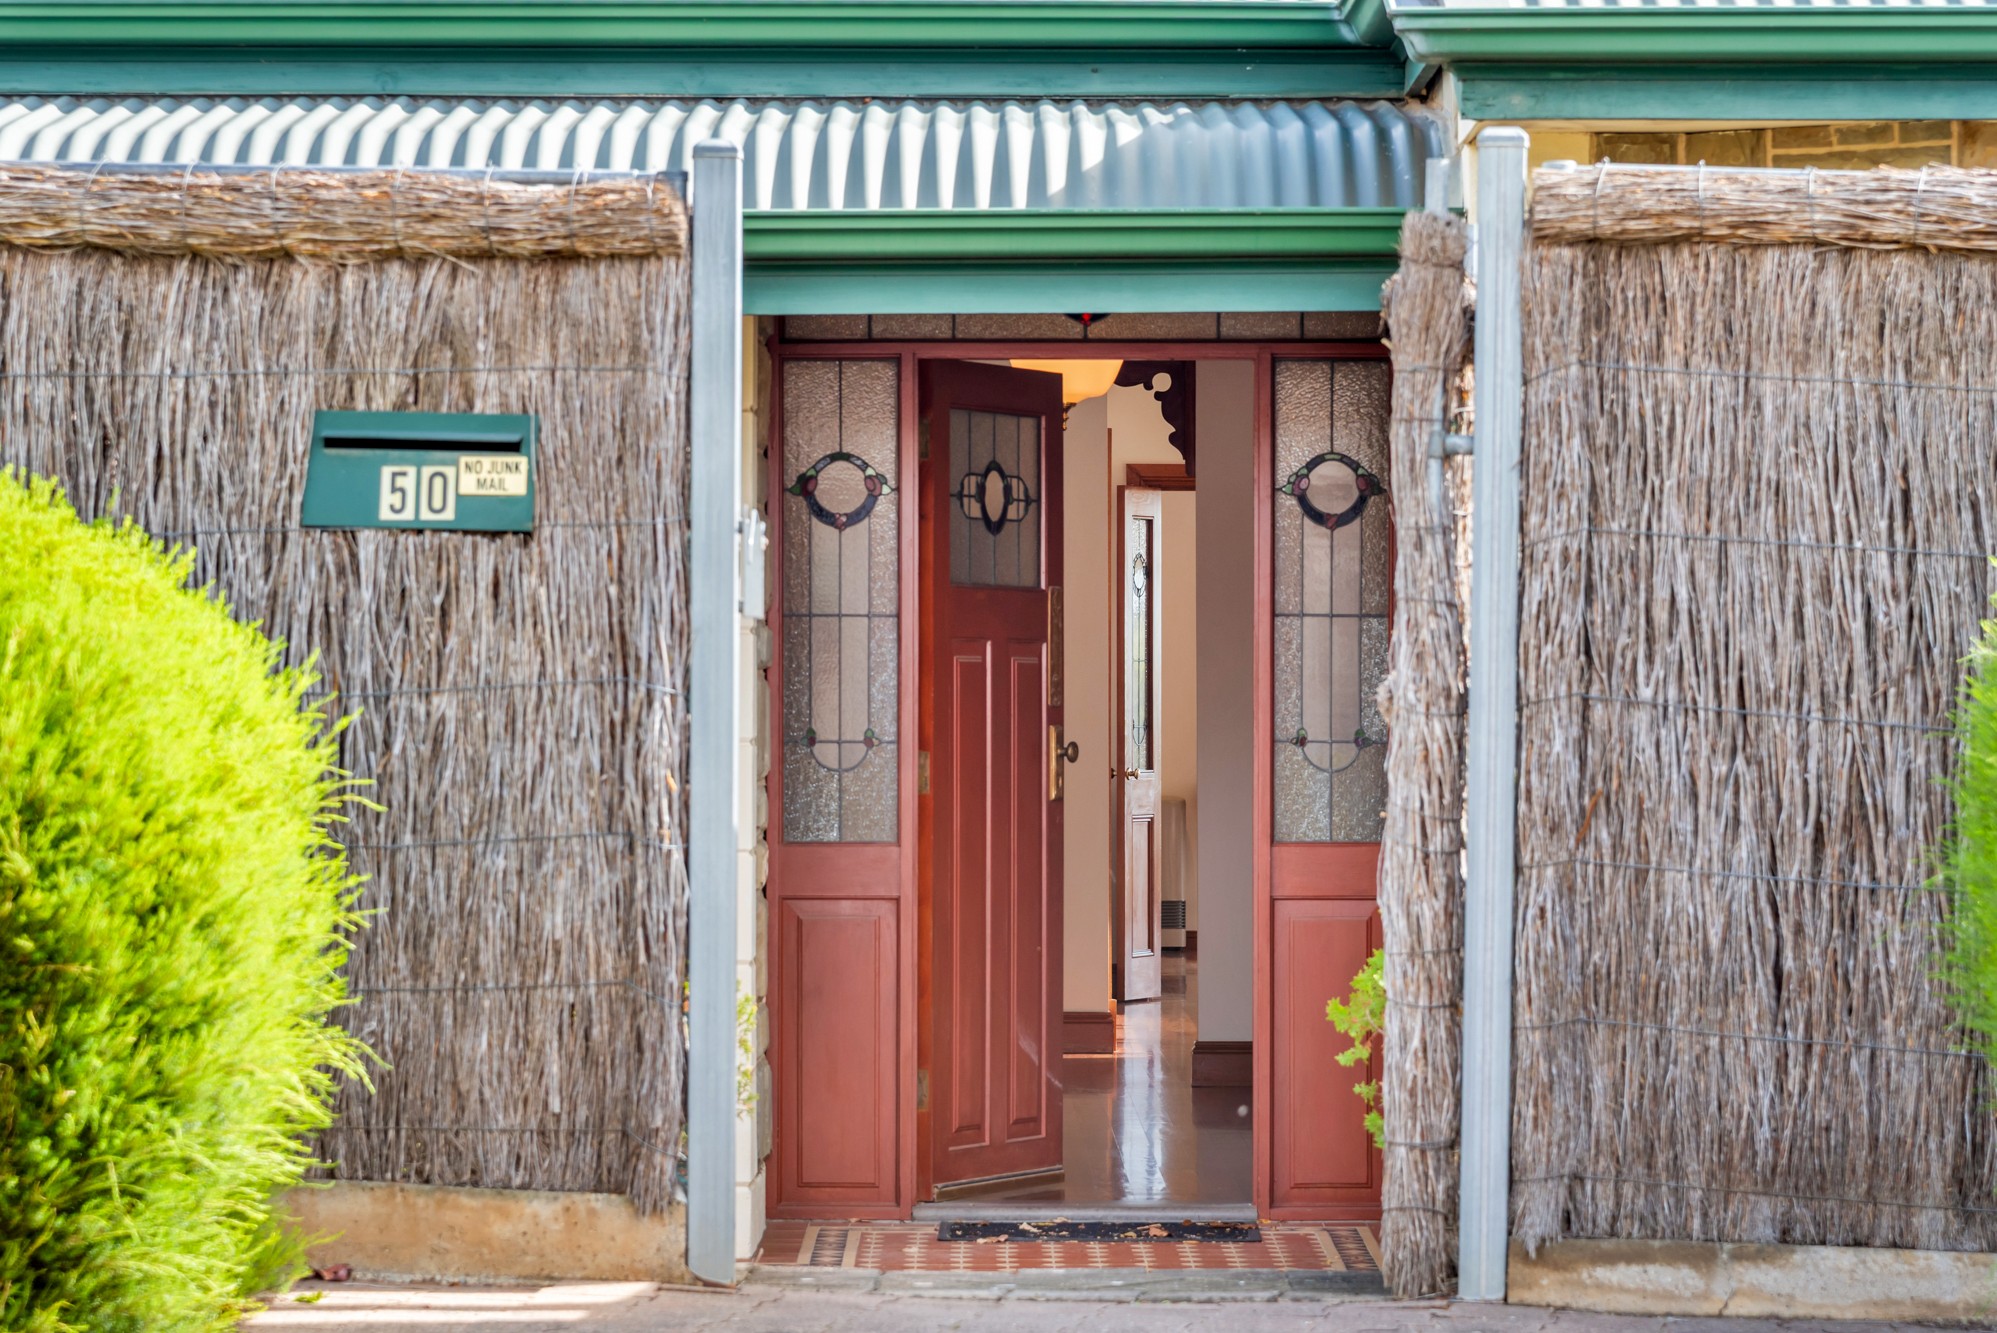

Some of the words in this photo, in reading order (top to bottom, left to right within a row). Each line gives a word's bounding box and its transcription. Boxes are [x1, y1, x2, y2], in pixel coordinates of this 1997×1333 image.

[464, 461, 482, 474] NO
[487, 460, 522, 474] JUNK
[476, 477, 508, 491] MAIL
[389, 471, 448, 514] 50
